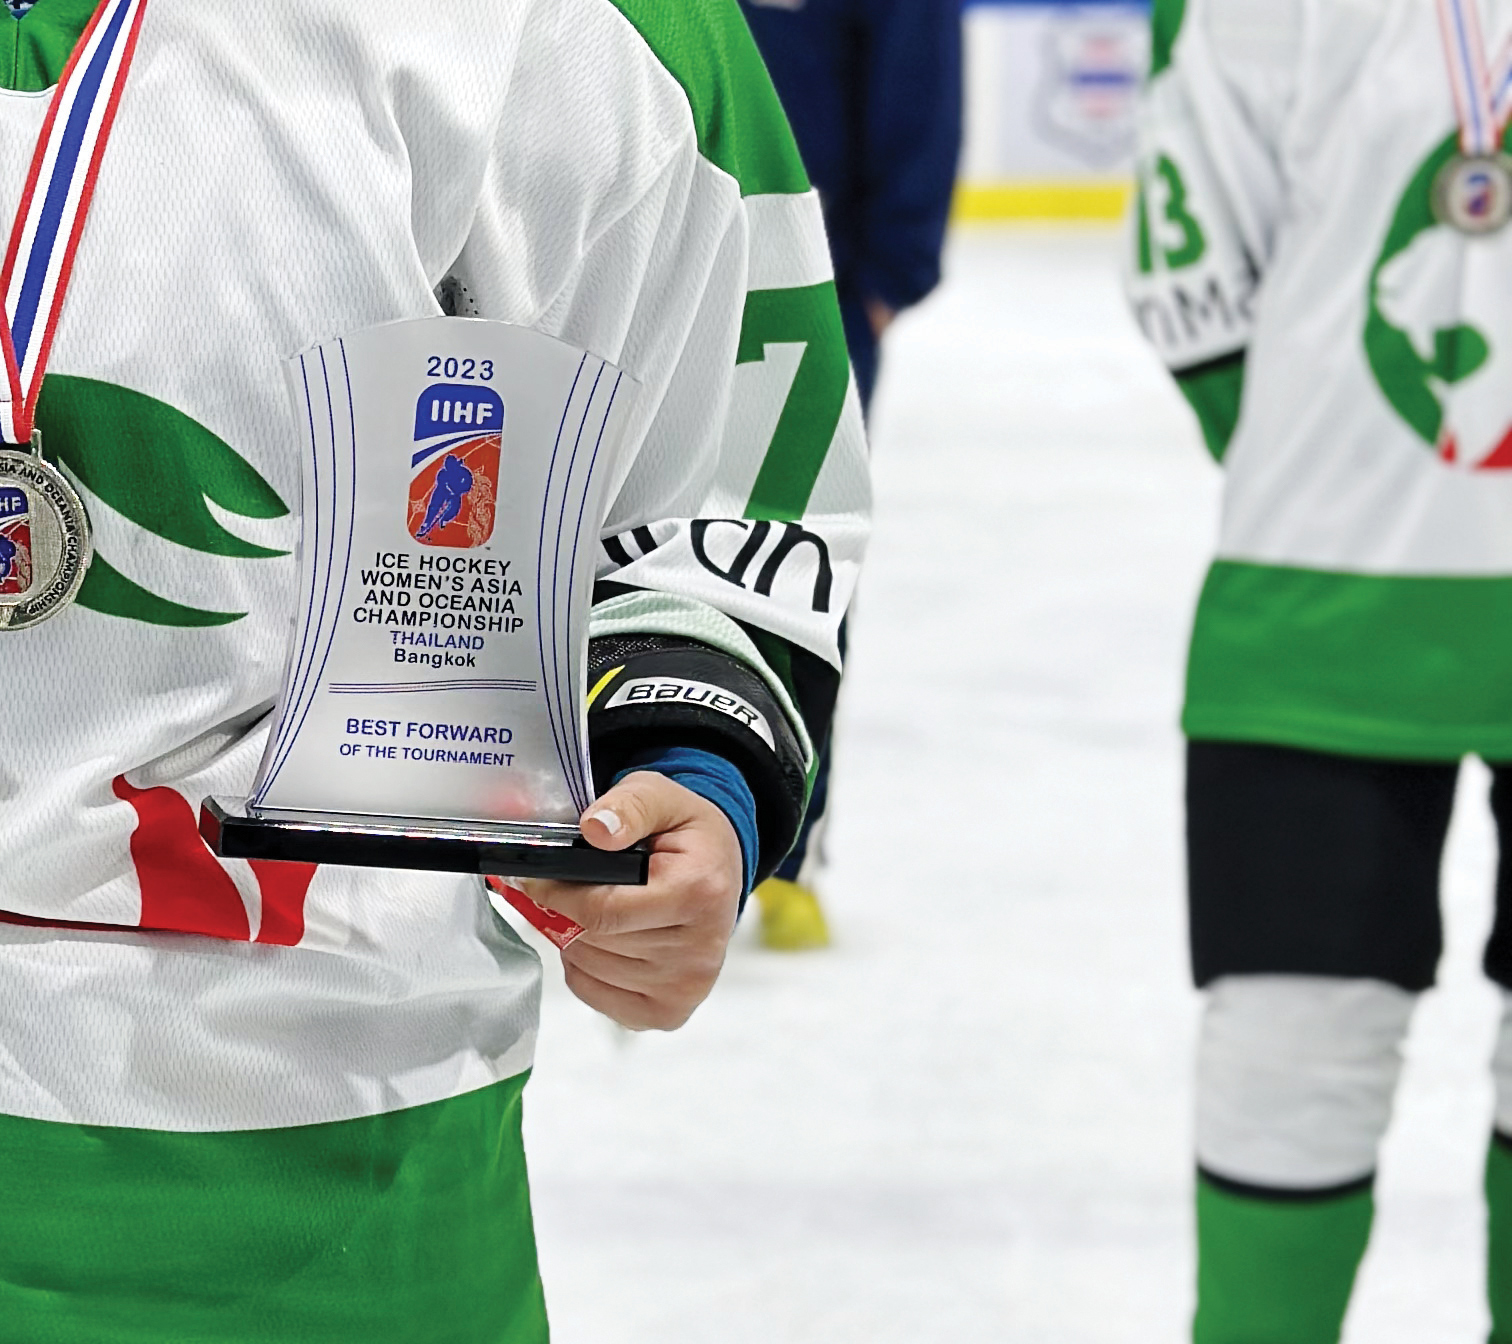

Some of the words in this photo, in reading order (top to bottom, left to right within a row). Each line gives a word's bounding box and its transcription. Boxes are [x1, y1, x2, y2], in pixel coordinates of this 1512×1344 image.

[426, 355, 495, 381] 2023
[430, 399, 494, 425] IIHF
[735, 280, 850, 521] 7
[18, 467, 44, 485] AND
[44, 483, 76, 533] OCEANIA
[28, 536, 78, 614] CHAMPIONSHIP
[375, 552, 410, 570] ICE
[419, 555, 512, 577] HOCKEY
[361, 569, 465, 592] WOMEN'S
[470, 577, 523, 596] ASIA
[364, 589, 411, 607] AND
[418, 592, 516, 615] OCEANIA
[352, 607, 524, 634] CHAMPIONSHIP
[389, 630, 485, 651] THAILAND
[393, 647, 476, 669] Bangkok
[345, 717, 401, 738] BEST
[406, 721, 514, 744] FORWARD
[339, 743, 362, 757] OF
[365, 744, 398, 760] THE
[402, 747, 516, 767] TOURNAMENT
